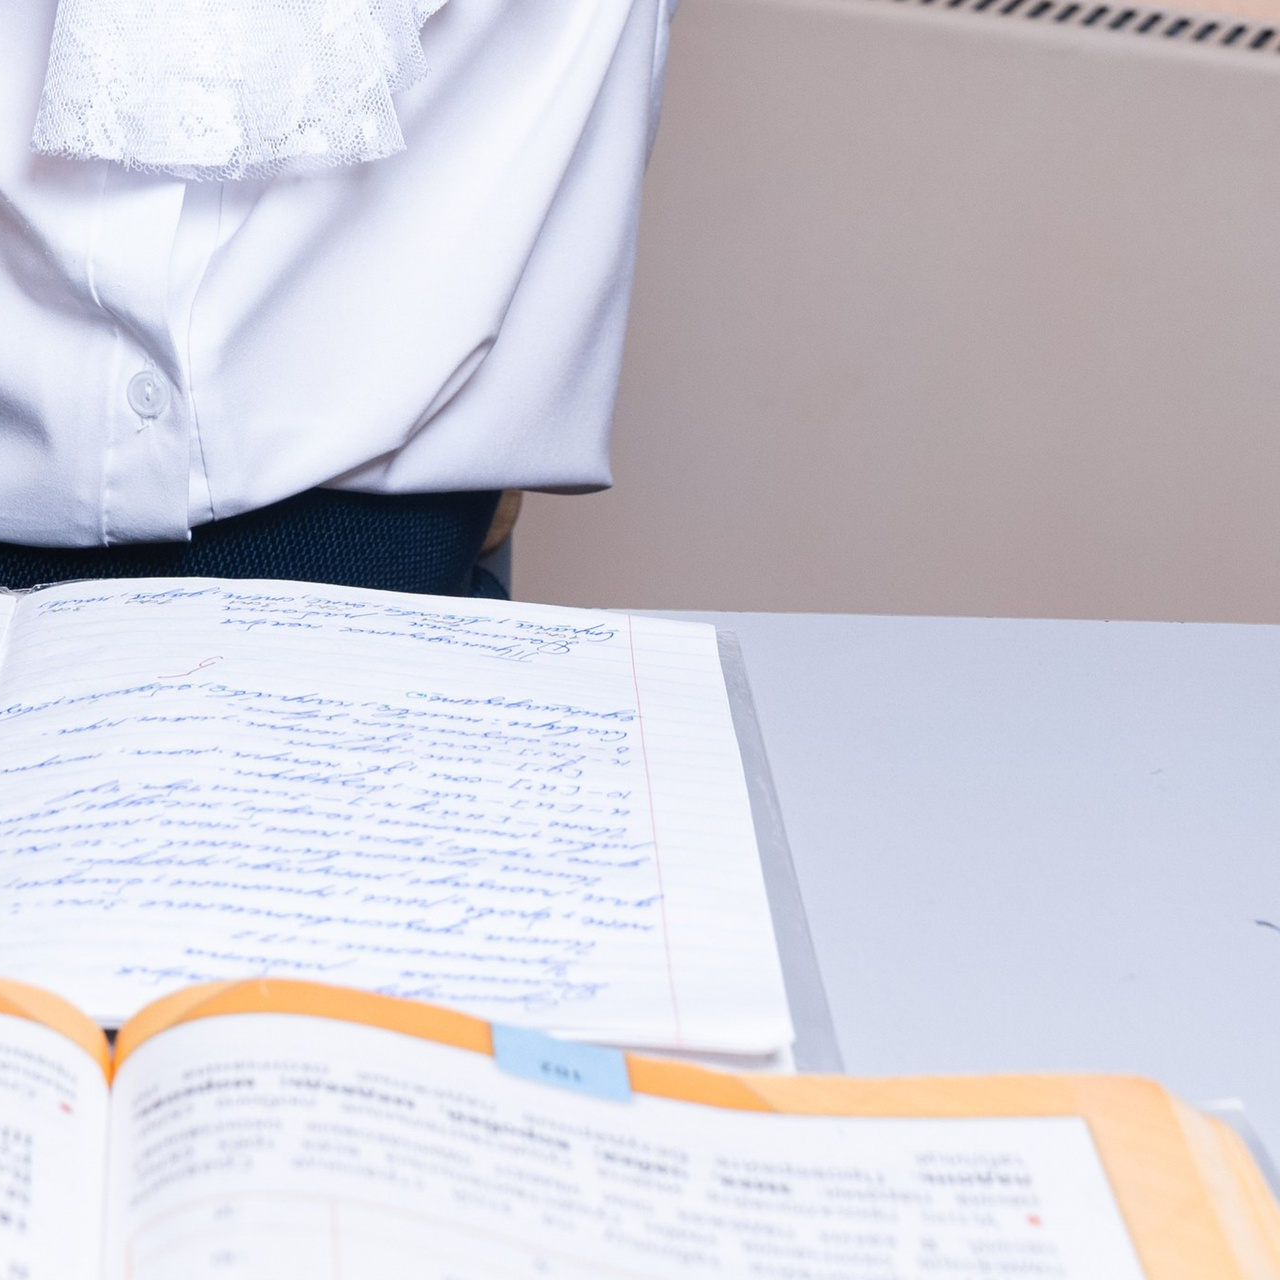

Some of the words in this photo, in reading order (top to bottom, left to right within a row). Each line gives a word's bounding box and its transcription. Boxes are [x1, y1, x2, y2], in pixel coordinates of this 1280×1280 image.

[219, 605, 379, 620] работа
[219, 618, 324, 632] ноября
[406, 621, 580, 655] Домашняя
[184, 948, 358, 978] работа
